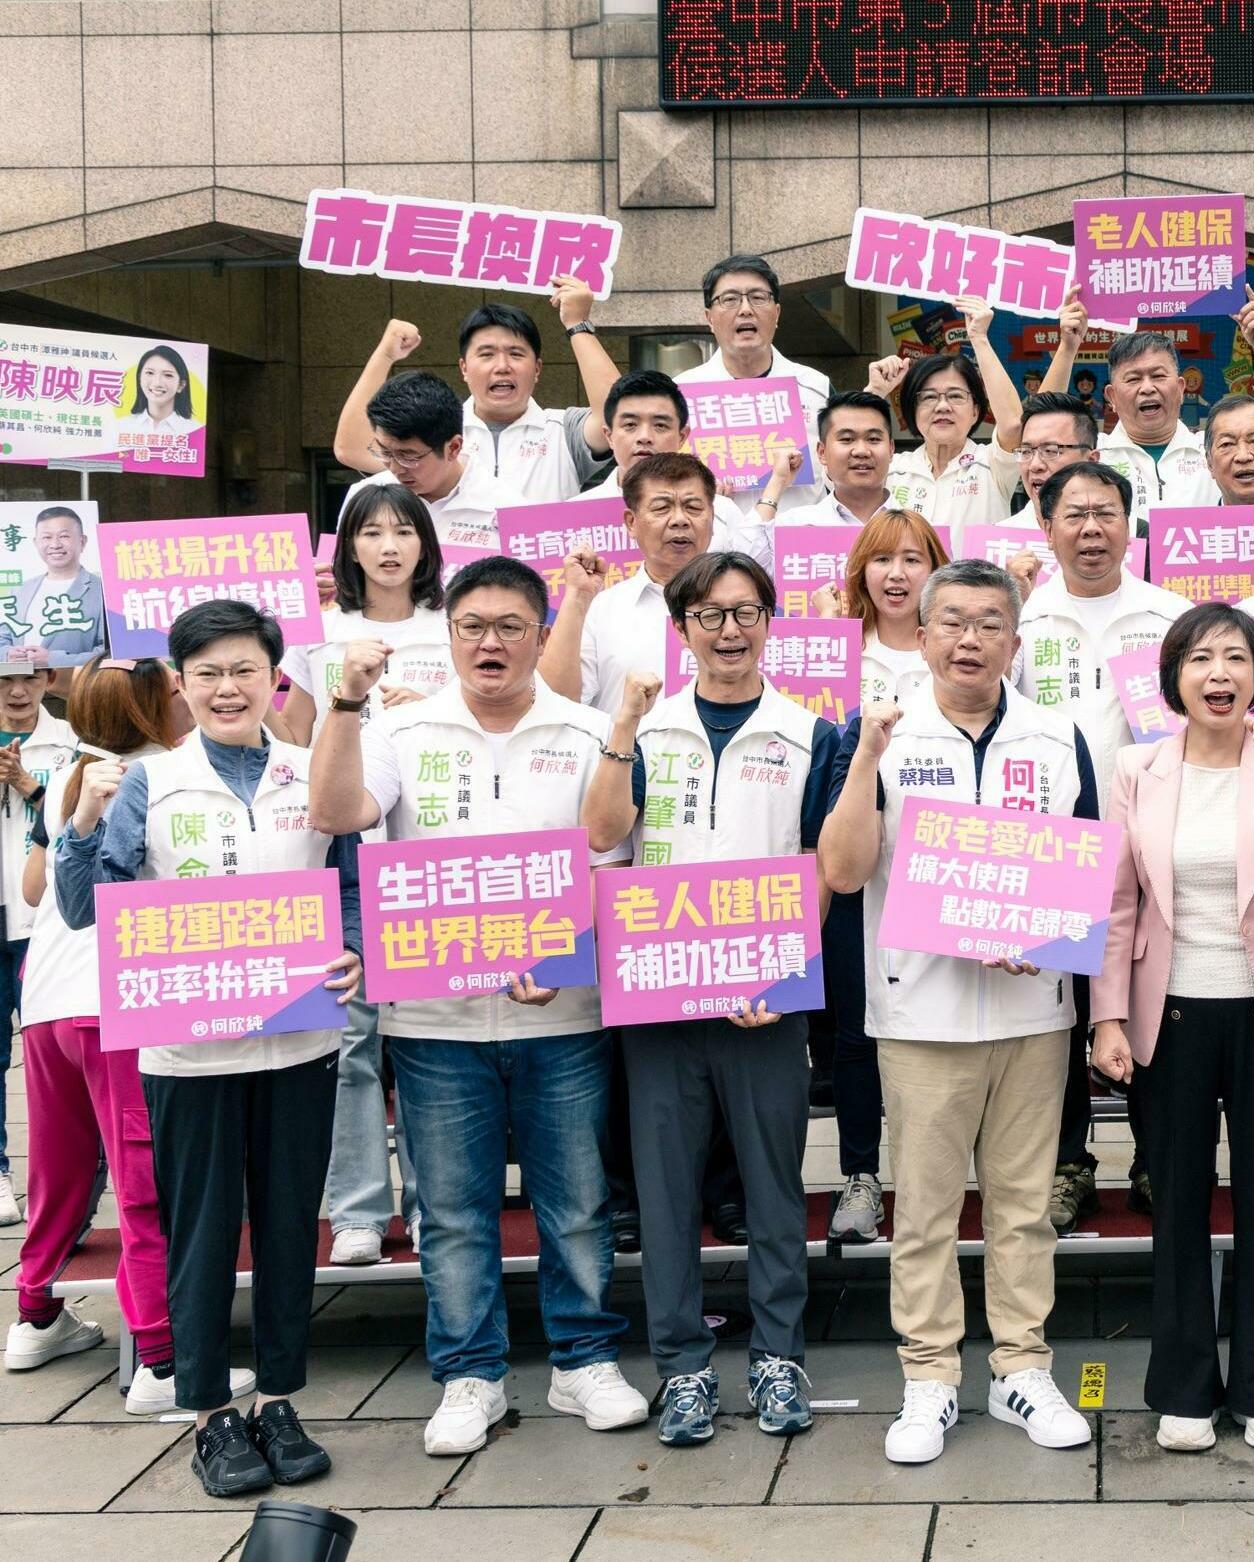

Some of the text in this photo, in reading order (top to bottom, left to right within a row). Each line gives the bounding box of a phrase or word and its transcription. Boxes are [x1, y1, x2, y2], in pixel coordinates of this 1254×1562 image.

[667, 36, 1215, 100] 候選人申請登記會場
[308, 196, 612, 294] 市長換欣
[1087, 208, 1233, 250] 老人健保
[854, 216, 1137, 320] 欣好市
[1088, 254, 1233, 295] 補助延續
[1150, 300, 1187, 314] 何欣純
[11, 342, 39, 352] 台中市
[71, 348, 118, 360] 議員候選人
[0, 358, 127, 407] 陳映辰
[686, 390, 792, 430] 活首都
[118, 432, 190, 448] 民進黨提名
[679, 431, 797, 471] 界舞台
[114, 531, 300, 582] 機場升級
[448, 529, 491, 546] 何欣純
[402, 668, 448, 686] 何欣純
[679, 635, 848, 681] 轉型
[1033, 637, 1063, 706] 謝志
[1067, 656, 1081, 700] 市議員
[529, 757, 578, 776] 何欣純
[740, 764, 791, 786] 何欣純
[899, 767, 956, 787] 蔡其昌
[903, 757, 944, 766] 主任委員
[416, 749, 451, 829] 施志
[456, 773, 472, 821] 市議員
[641, 751, 681, 866] 江肇國
[683, 776, 701, 826] 市議員
[913, 809, 1103, 869] 敬老愛心卡
[377, 848, 574, 911] 生活首都
[906, 852, 1030, 897] 擴大使用
[612, 872, 804, 933] 老人健保
[939, 894, 1093, 943] 點數不歸零
[114, 894, 325, 959] 捷運路網
[380, 909, 577, 970] 世界舞台
[975, 938, 1024, 960] 何欣純
[615, 931, 808, 993] 補助延續
[211, 1014, 264, 1035] 何欣純
